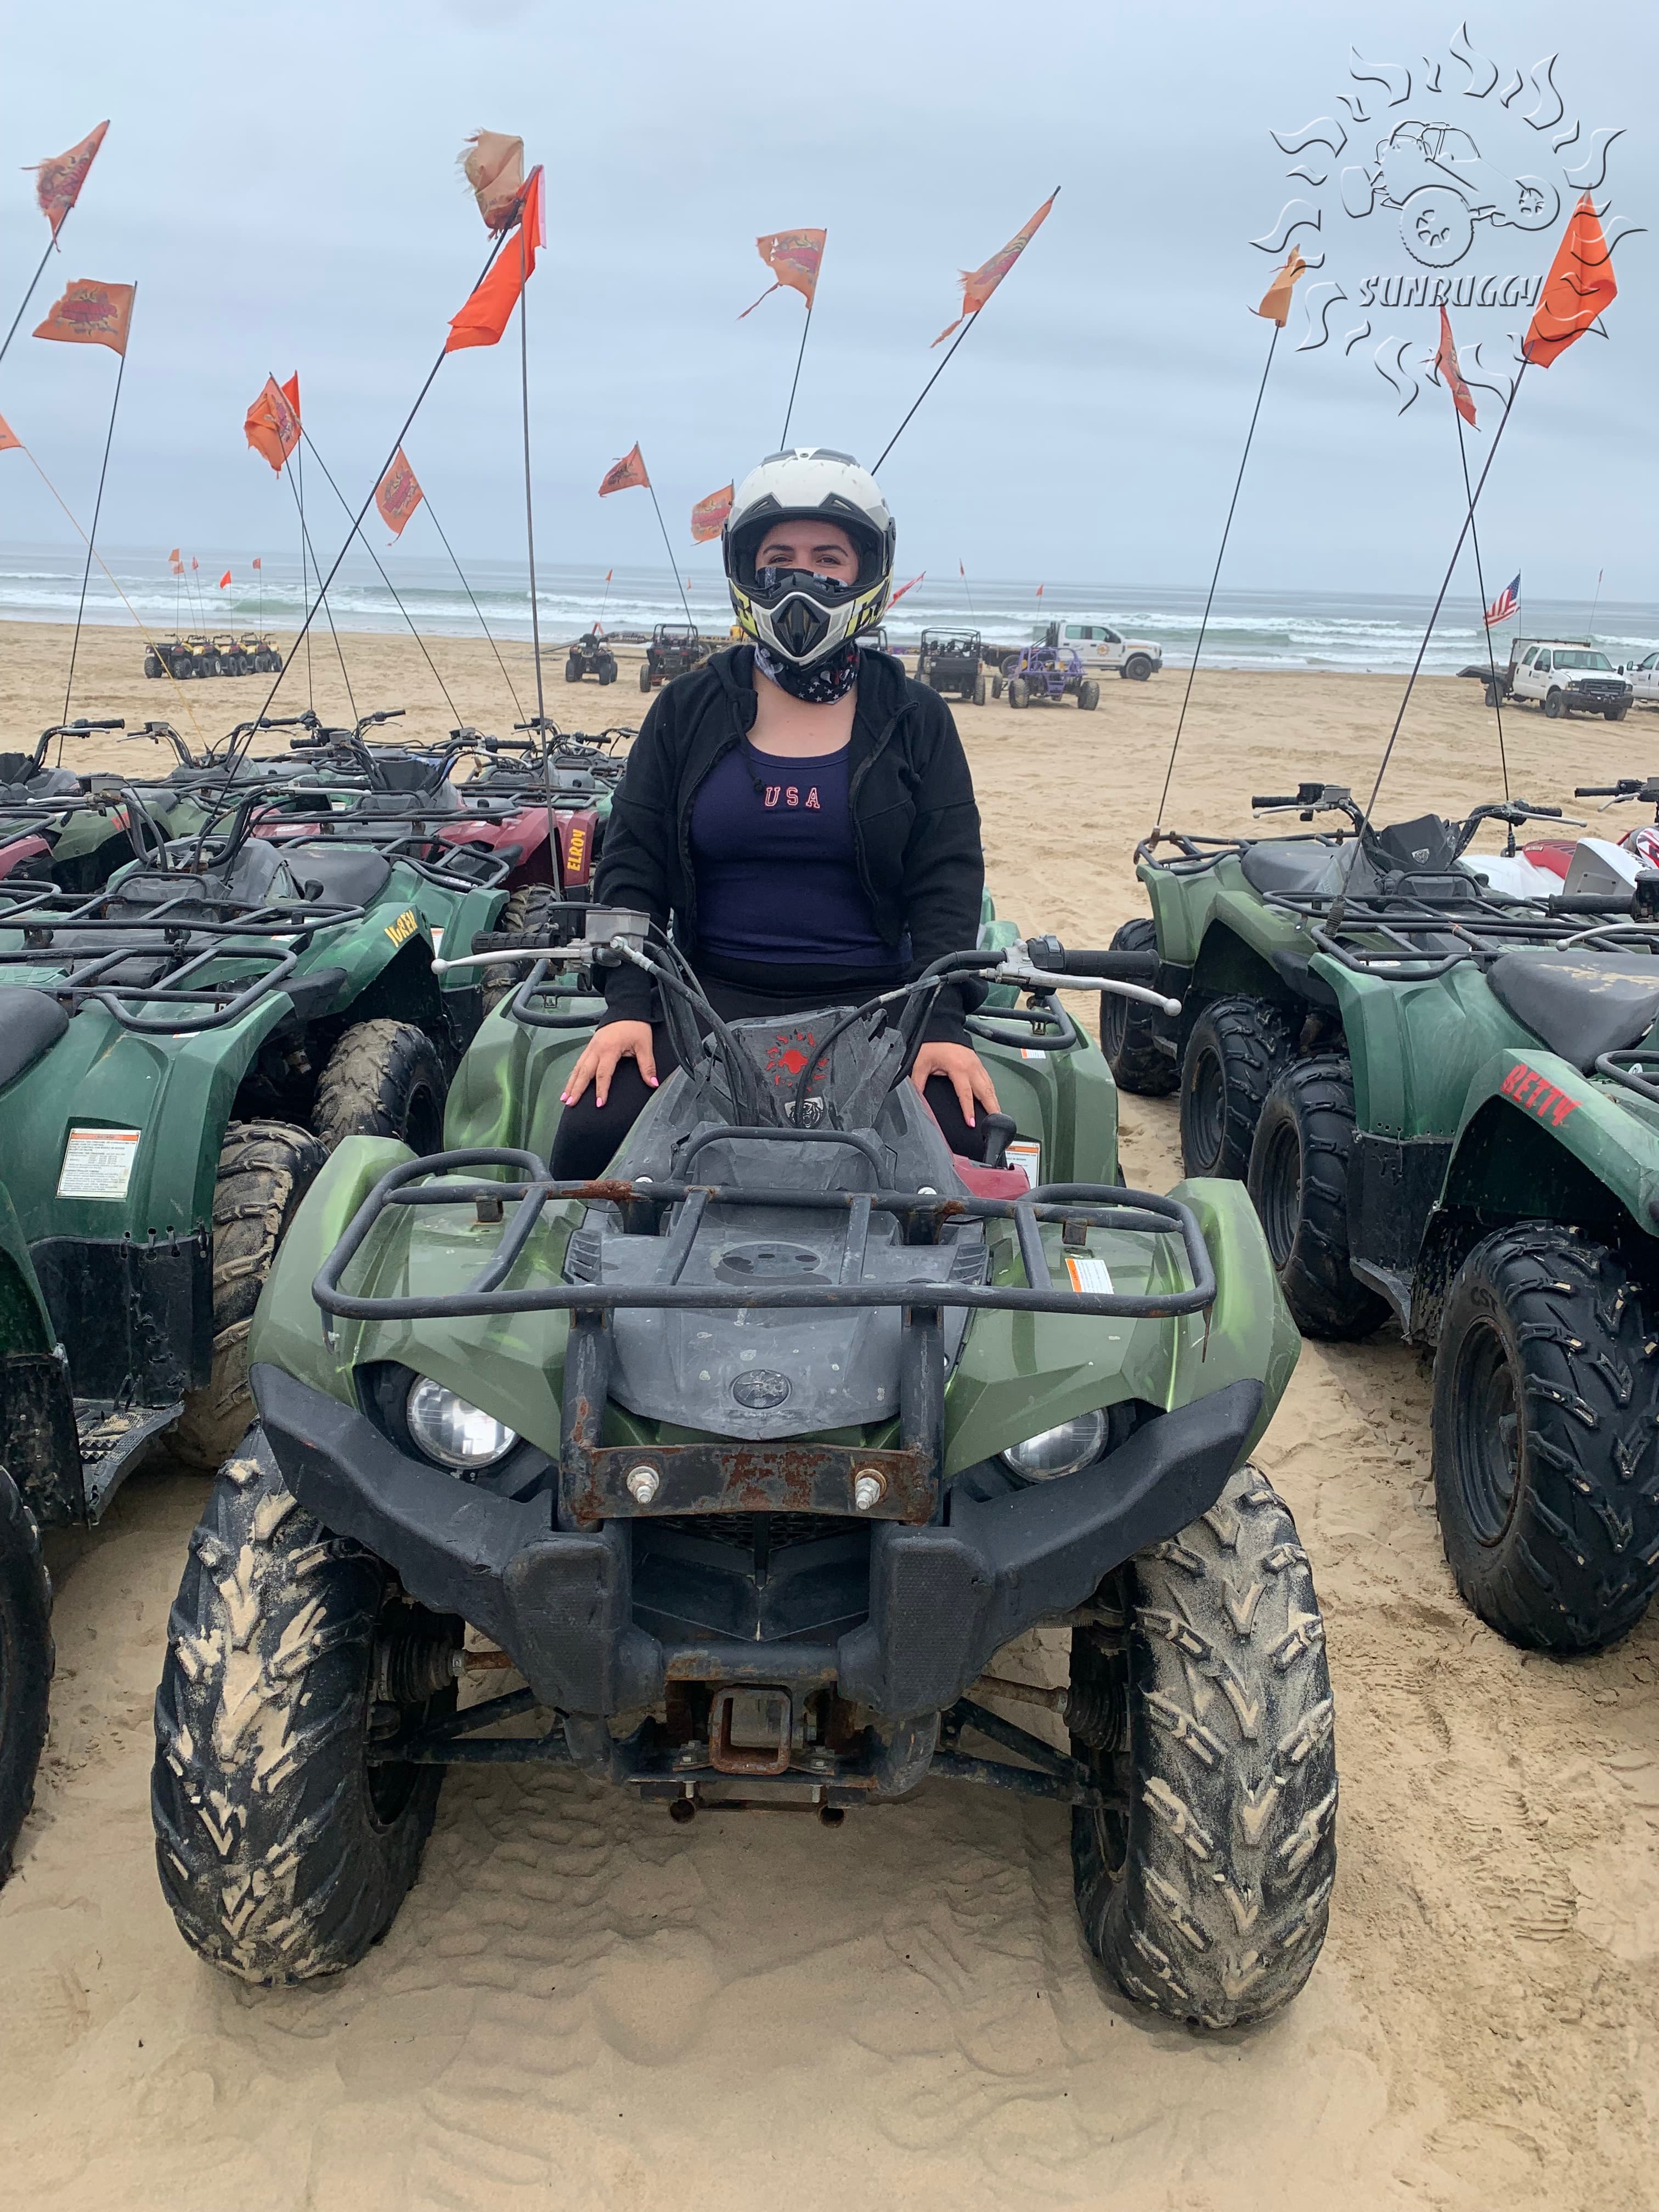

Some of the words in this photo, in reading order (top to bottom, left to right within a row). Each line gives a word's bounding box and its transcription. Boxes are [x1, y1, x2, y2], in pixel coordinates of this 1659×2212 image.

[765, 787, 820, 809] USA
[567, 829, 586, 871] ELROY
[1500, 1063, 1583, 1126] BETTY
